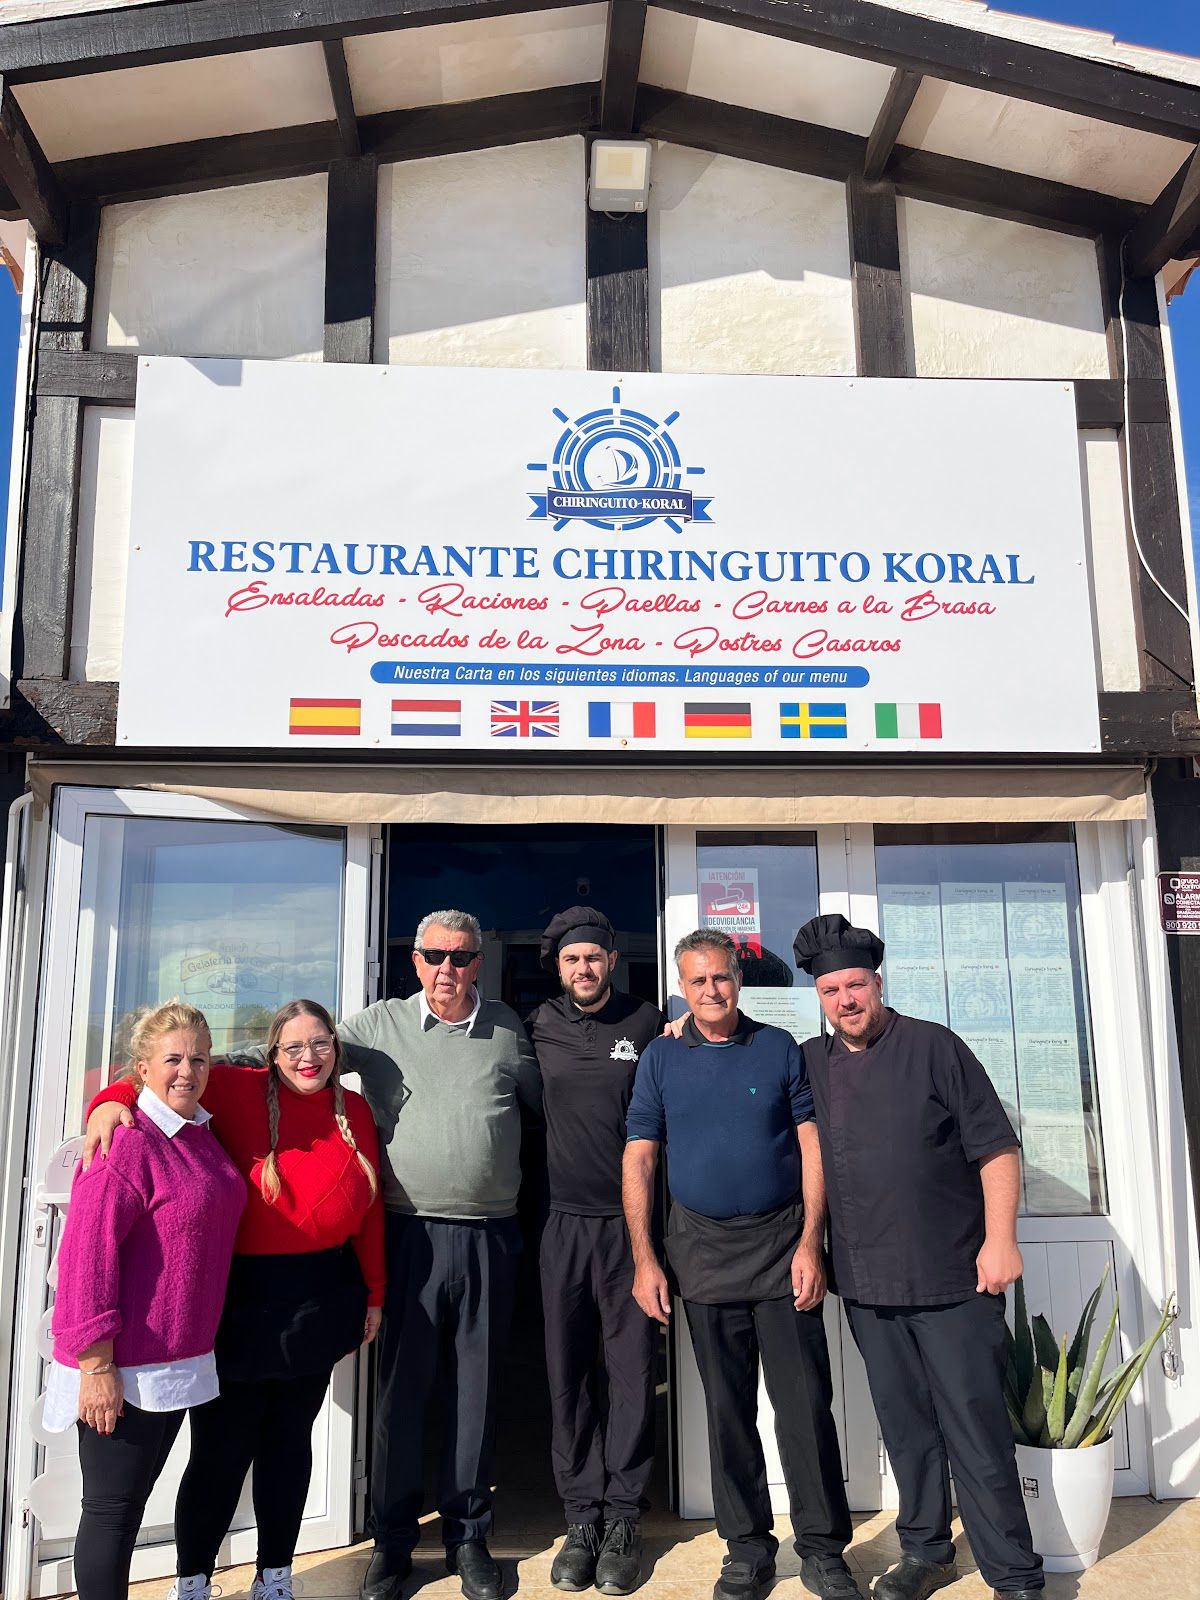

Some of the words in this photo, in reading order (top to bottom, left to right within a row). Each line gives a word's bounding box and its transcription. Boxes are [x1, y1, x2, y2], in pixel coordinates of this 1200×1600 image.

[552, 496, 687, 510] CHIRINGUITO-KORAL
[187, 540, 540, 579] RESTAURANTE
[552, 547, 871, 583] CHIRINGUITO
[883, 551, 1035, 585] KORAL
[225, 580, 385, 617] Ensaladas
[417, 582, 548, 617] Raciones
[580, 587, 701, 618] Paellas
[732, 590, 828, 620] Carnes
[837, 602, 857, 615] a
[862, 595, 893, 615] la
[900, 589, 996, 622] Brasa
[330, 621, 470, 653] Pescados
[478, 629, 511, 650] de
[516, 630, 549, 650] la
[555, 623, 646, 656] Zona
[673, 626, 783, 658] Postres
[792, 629, 902, 659] Casaros
[393, 665, 450, 680] Nuestra
[455, 666, 493, 680] Carta
[498, 669, 515, 681] en
[519, 667, 541, 682] los
[545, 667, 617, 684] siguientes
[621, 668, 680, 683] idiomas.
[684, 669, 760, 685] Languages
[764, 669, 779, 683] of
[782, 672, 806, 683] our
[809, 671, 848, 684] menu
[703, 916, 755, 926] VIDEOVIGILANCIA
[1165, 921, 1180, 929] 900
[1182, 921, 1197, 929] 920
